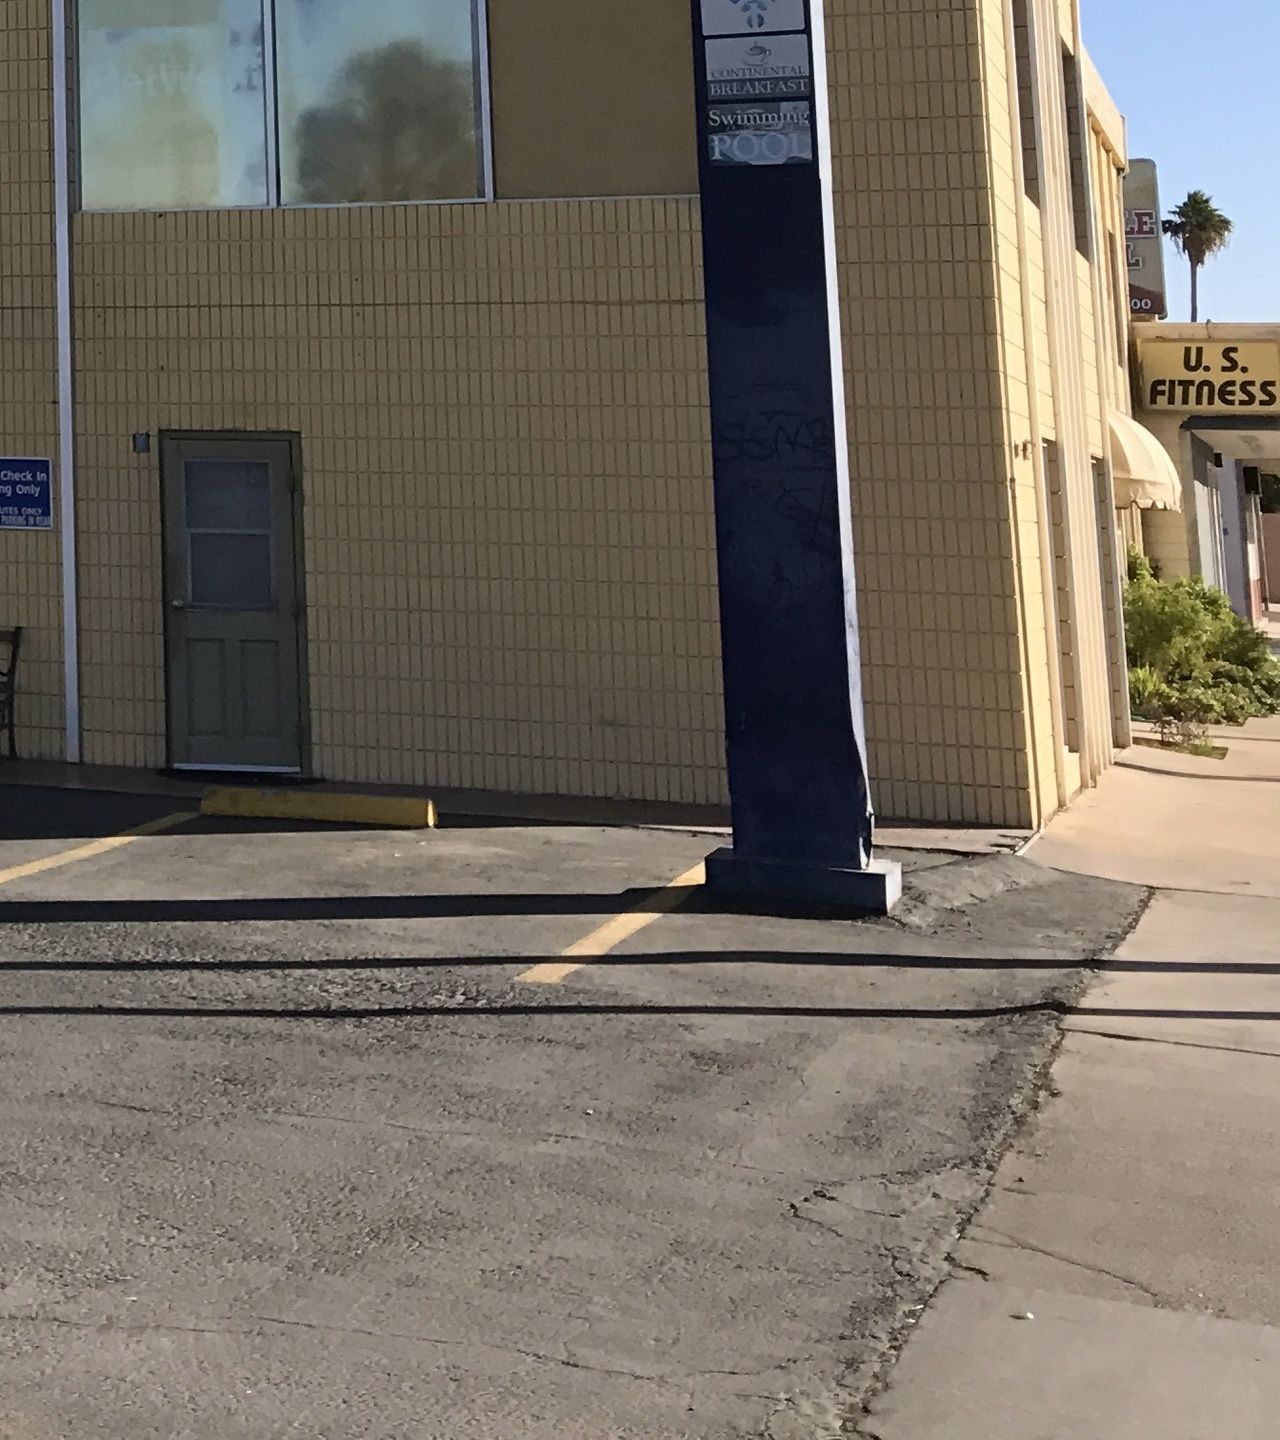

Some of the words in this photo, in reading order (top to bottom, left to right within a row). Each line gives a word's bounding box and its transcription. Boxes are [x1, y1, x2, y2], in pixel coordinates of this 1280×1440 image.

[711, 65, 805, 79] CONTINENTAL
[710, 79, 809, 96] BREAKFAST
[708, 109, 810, 127] Swimming
[1183, 346, 1211, 373] U.
[1221, 346, 1249, 374] S.
[1149, 379, 1278, 406] FITNESS
[0, 470, 33, 481] Check
[37, 471, 47, 481] In
[16, 484, 41, 497] Only
[21, 507, 43, 515] ONLY
